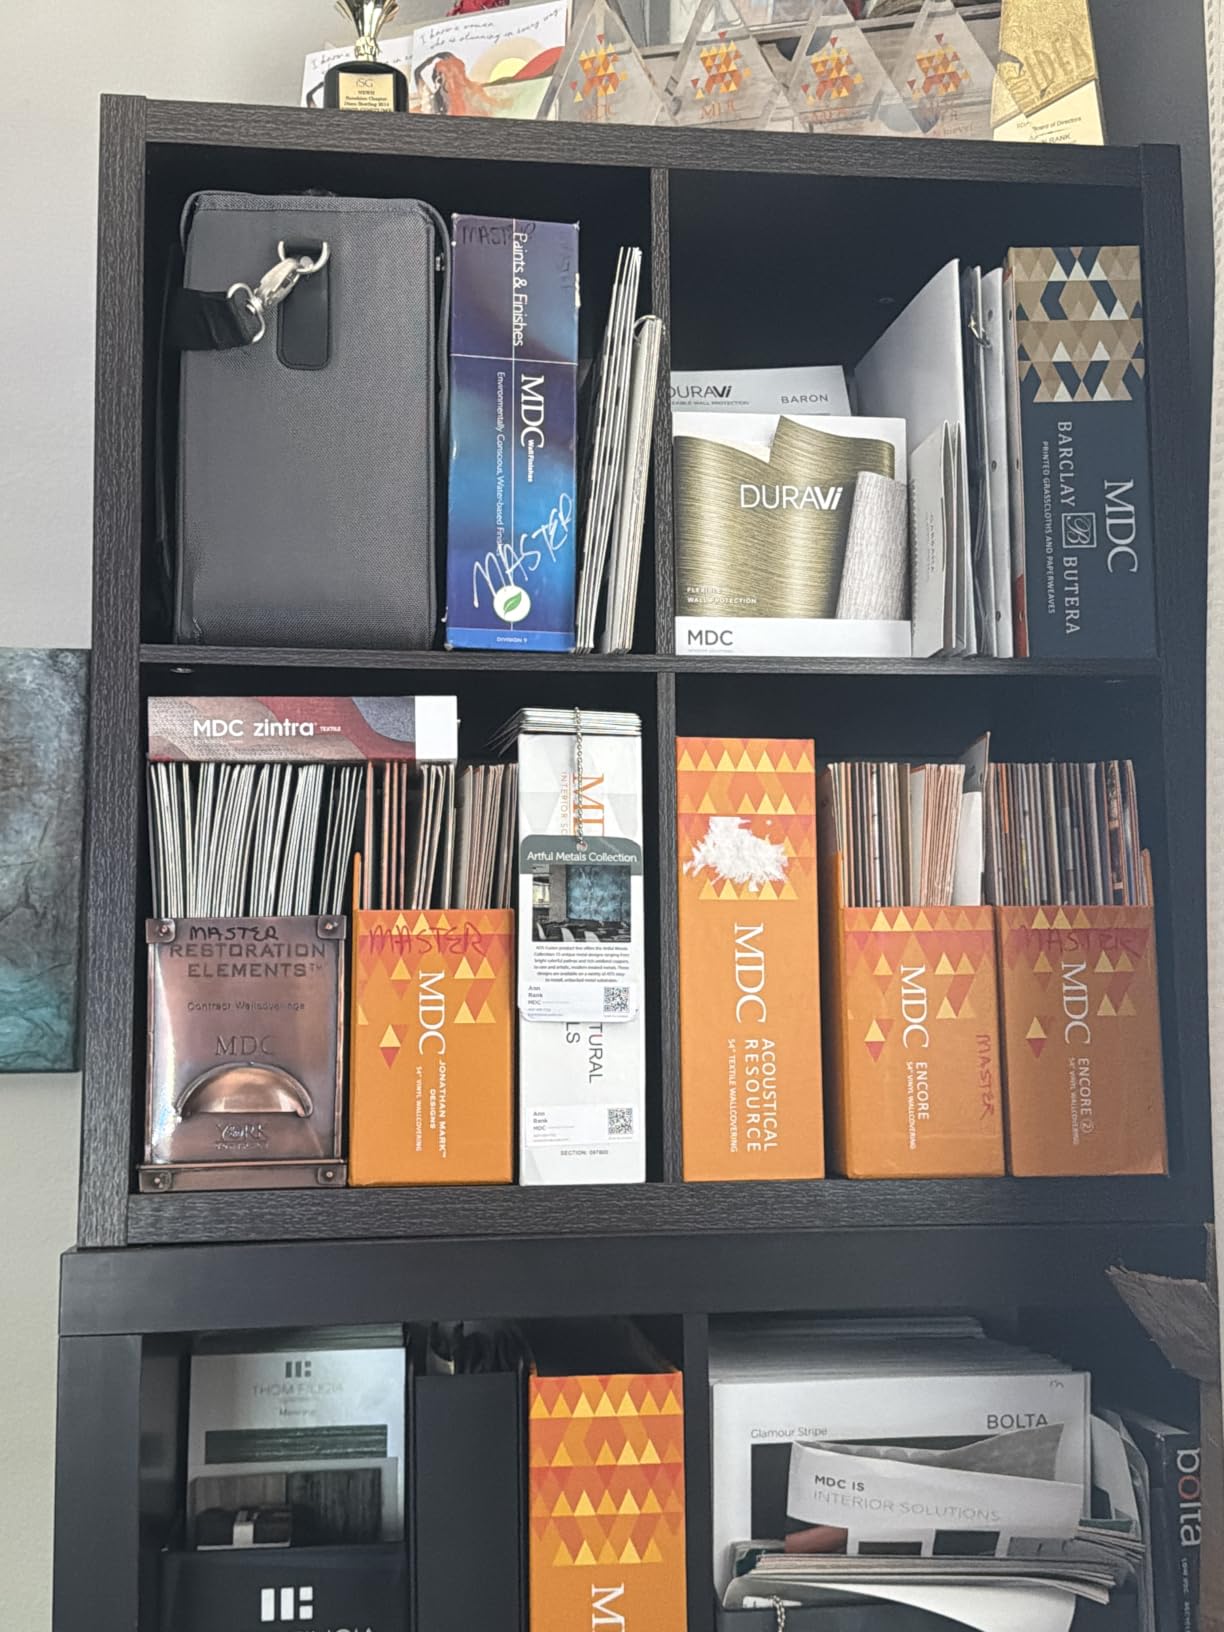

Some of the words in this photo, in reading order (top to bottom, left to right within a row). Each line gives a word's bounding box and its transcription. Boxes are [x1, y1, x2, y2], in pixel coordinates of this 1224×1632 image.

[512, 232, 528, 273] Paints
[512, 277, 528, 289] &
[512, 294, 528, 347] Finishes
[496, 371, 506, 432] Environmentally
[520, 373, 545, 450] MDC
[780, 394, 829, 404] BARON
[1042, 440, 1050, 476] PRINTED
[1057, 420, 1076, 507] BARCLAY
[496, 476, 506, 525] Water-based
[1043, 477, 1053, 534] GRASSCLOTHS
[1104, 478, 1139, 574] MDC
[472, 492, 573, 609] MASTER
[1045, 536, 1053, 554] AND
[1046, 555, 1056, 615] PAPERWEAVES
[1063, 556, 1081, 634] BUTERA
[687, 629, 734, 647] MDC
[193, 719, 244, 737] MDC
[253, 718, 315, 737] zintra
[527, 851, 554, 862] Artful
[556, 851, 587, 862] Metals
[588, 851, 638, 863] Collection
[169, 943, 326, 958] RESTORATION
[189, 924, 279, 942] MASTER
[368, 921, 488, 958] MASTER
[734, 922, 767, 1024] MDC
[418, 969, 446, 1056] MDC
[900, 964, 930, 1049] MDC
[1061, 961, 1091, 1045] MDC
[215, 1035, 273, 1056] MDC
[728, 1055, 737, 1086] TEXTILE
[438, 1059, 447, 1117] JONATHAN
[744, 1039, 761, 1152] RESOURCE
[761, 1038, 778, 1152] ACOUSTICAL
[907, 1075, 915, 1094] VINYL
[915, 1061, 930, 1120] ENCORE
[975, 1033, 994, 1121] MASTER
[1078, 1057, 1092, 1116] ENCORE
[415, 1100, 423, 1152] WALLCOVERING
[429, 1088, 437, 1129] DESIGNS
[728, 1087, 738, 1152] WALLCOVERING
[908, 1096, 917, 1150] WALLCOVERING
[750, 1427, 795, 1439] Glamour
[797, 1426, 829, 1438] Stripe
[986, 1413, 1049, 1430] BOLTA
[813, 1491, 895, 1512] INTERIOR
[899, 1502, 1001, 1522] SOLUTIONS
[814, 1475, 846, 1489] MDC
[852, 1482, 865, 1492] IS
